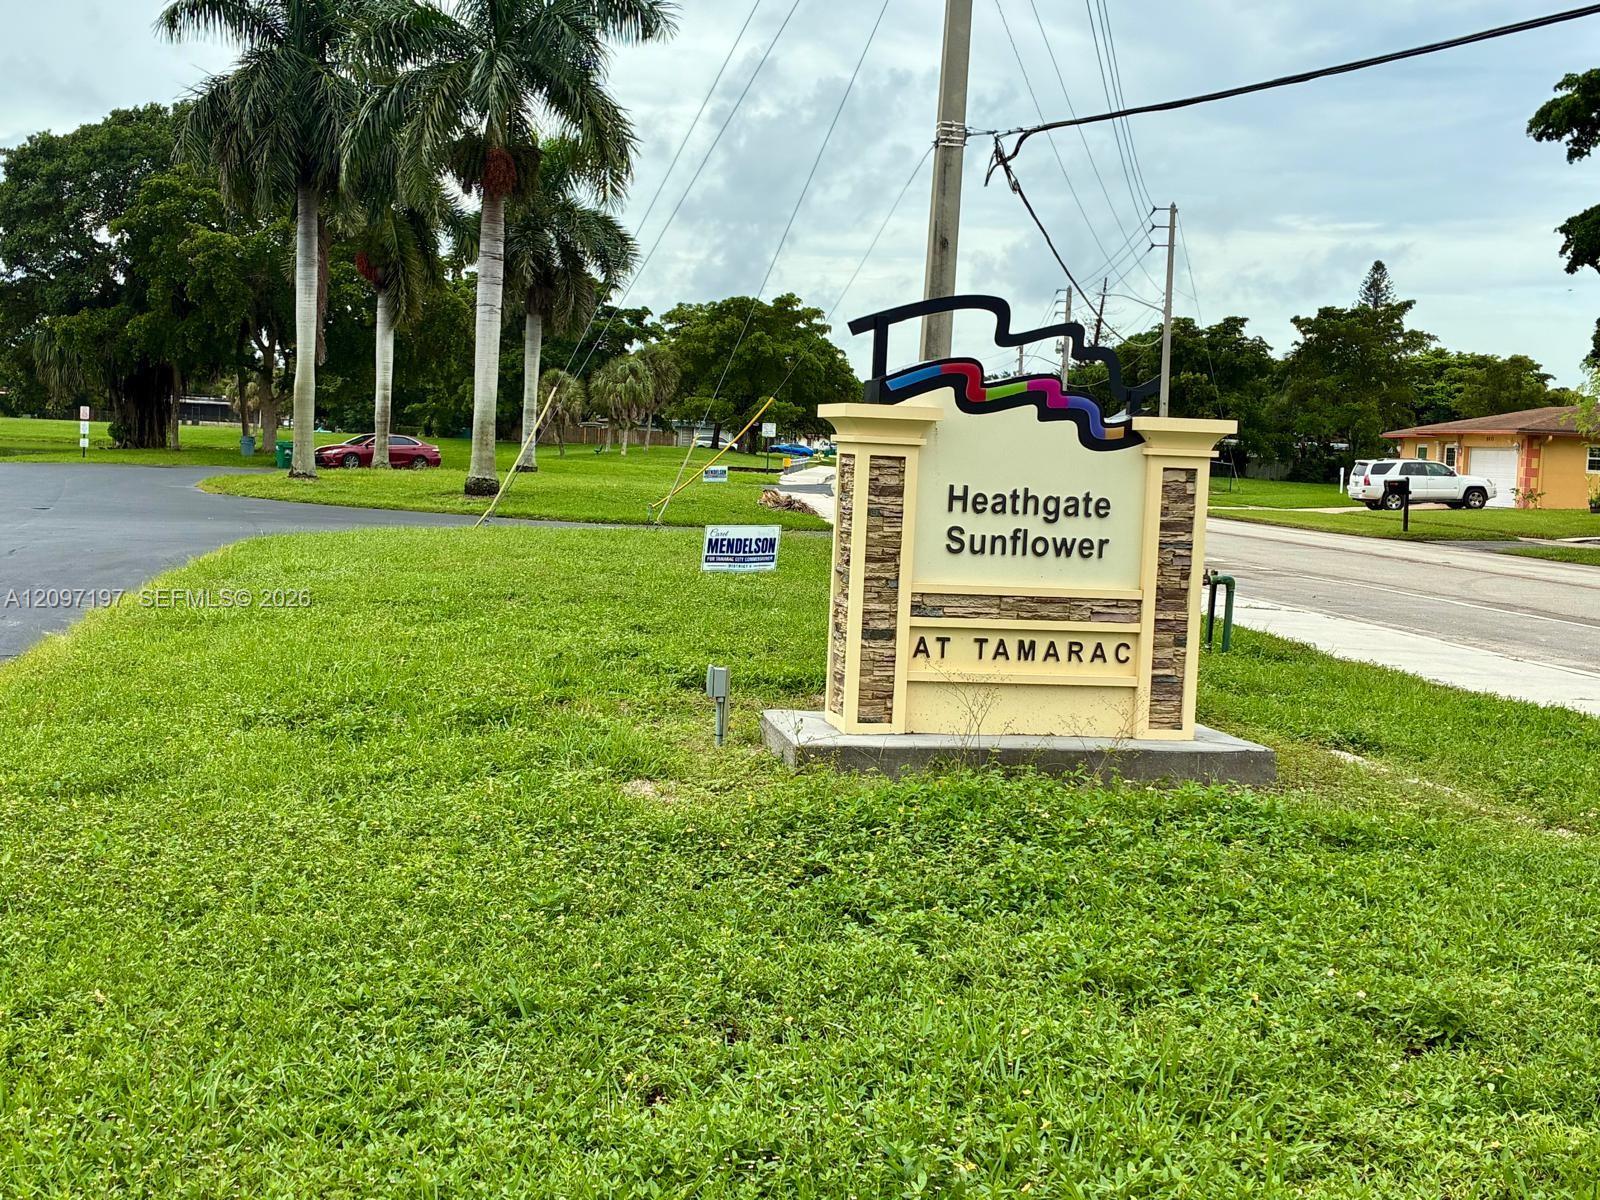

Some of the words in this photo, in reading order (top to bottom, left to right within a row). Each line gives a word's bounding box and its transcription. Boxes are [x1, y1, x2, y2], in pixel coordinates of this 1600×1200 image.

[947, 484, 1112, 524] Heathgate
[707, 538, 776, 554] MENDELSON
[945, 525, 1111, 560] Sunflower
[912, 636, 952, 660] AT
[973, 637, 1132, 664] TAMARAC
